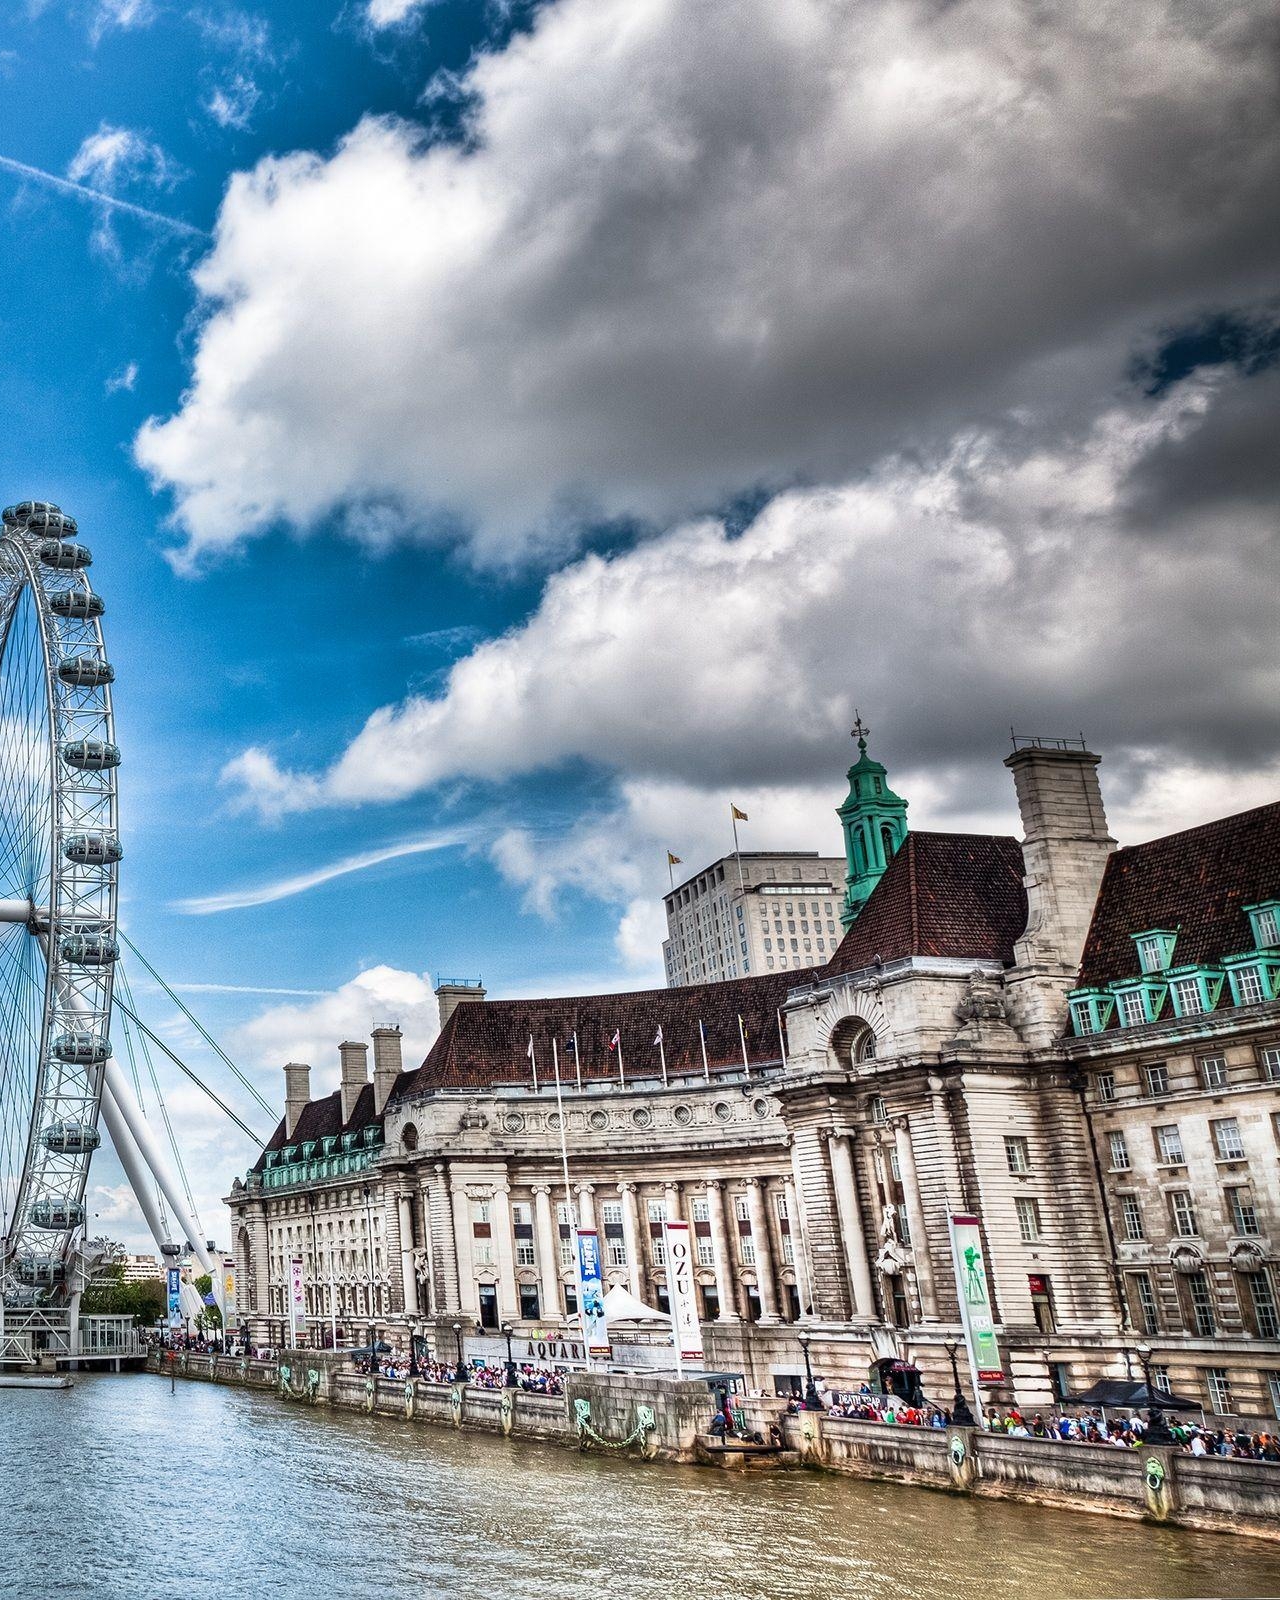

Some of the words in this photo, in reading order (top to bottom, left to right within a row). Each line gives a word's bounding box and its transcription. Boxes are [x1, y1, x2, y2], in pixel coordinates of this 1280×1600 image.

[673, 1243, 689, 1295] OZU
[527, 1341, 614, 1360] AQUARI
[839, 1394, 860, 1405] DEATH
